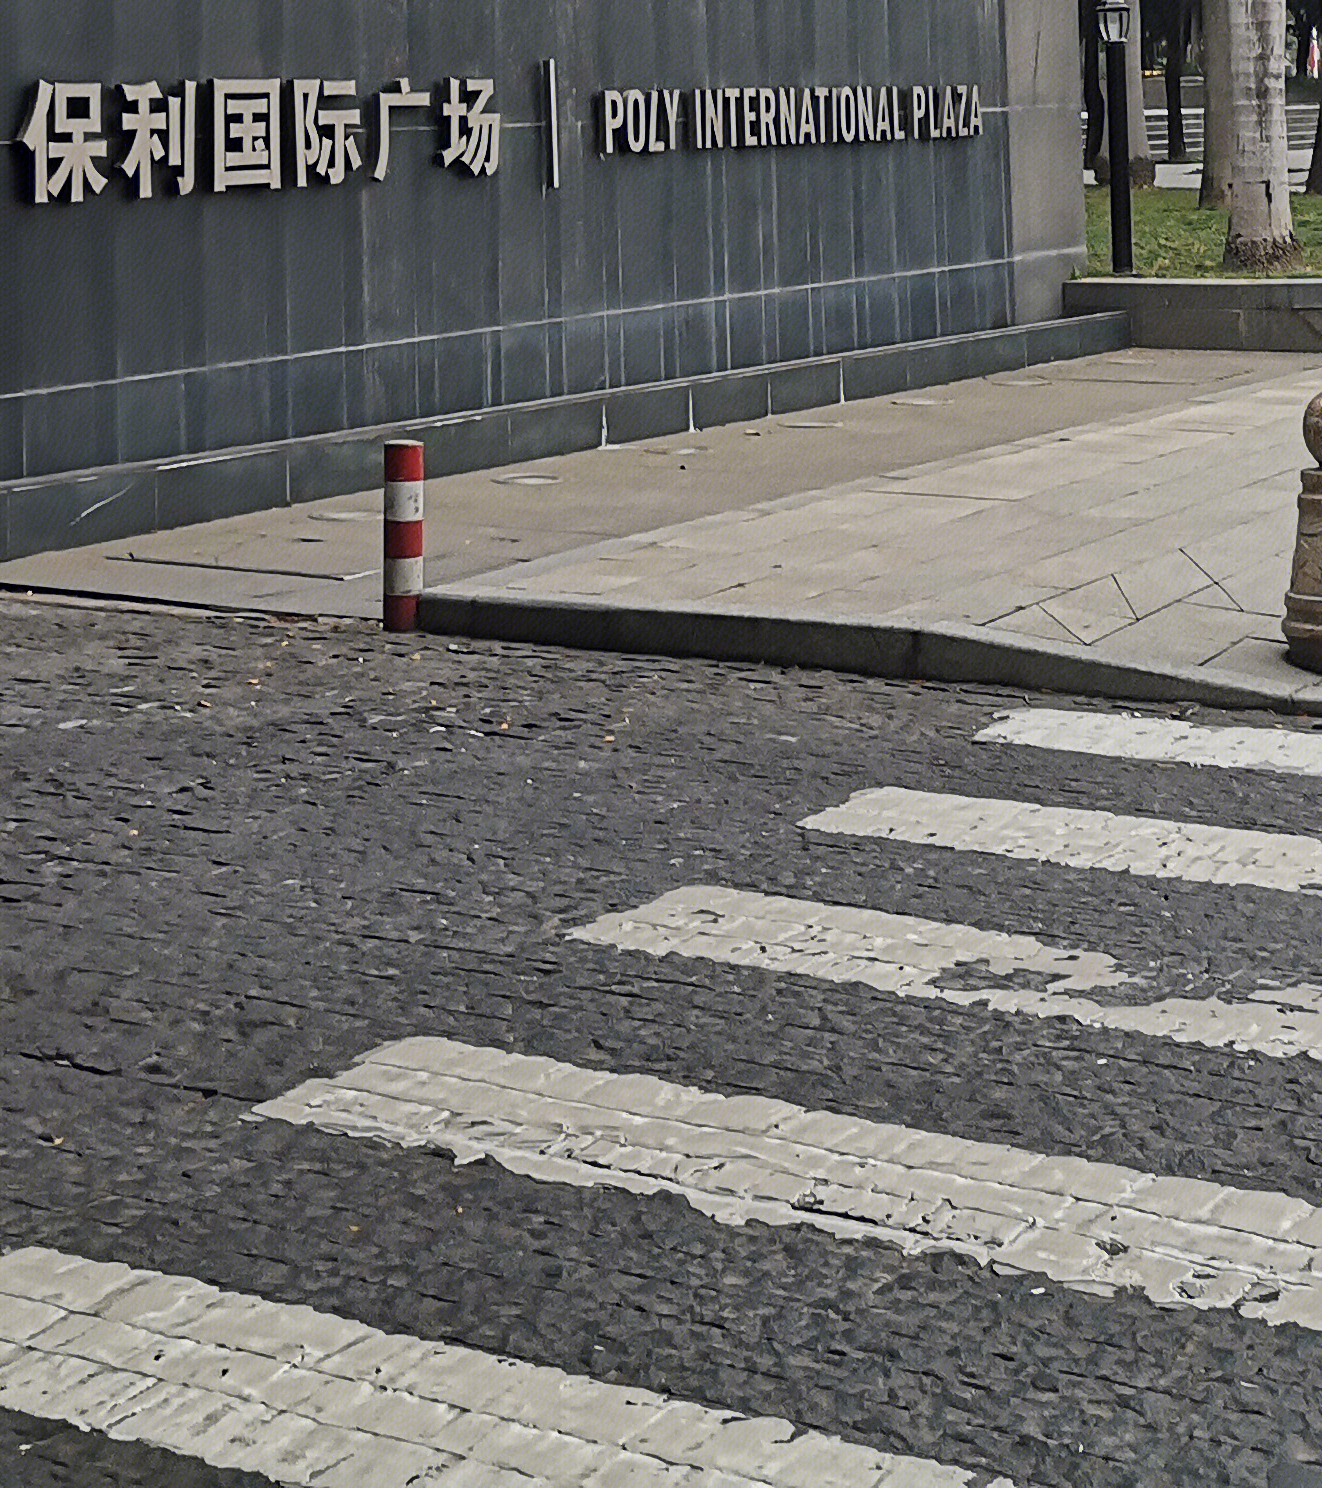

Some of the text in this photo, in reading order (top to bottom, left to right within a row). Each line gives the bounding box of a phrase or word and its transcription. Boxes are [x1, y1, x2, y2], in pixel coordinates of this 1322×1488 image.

[17, 77, 502, 203] 保利国际广场
[603, 84, 984, 154] POLY INTERNATIONAL PLAZA
